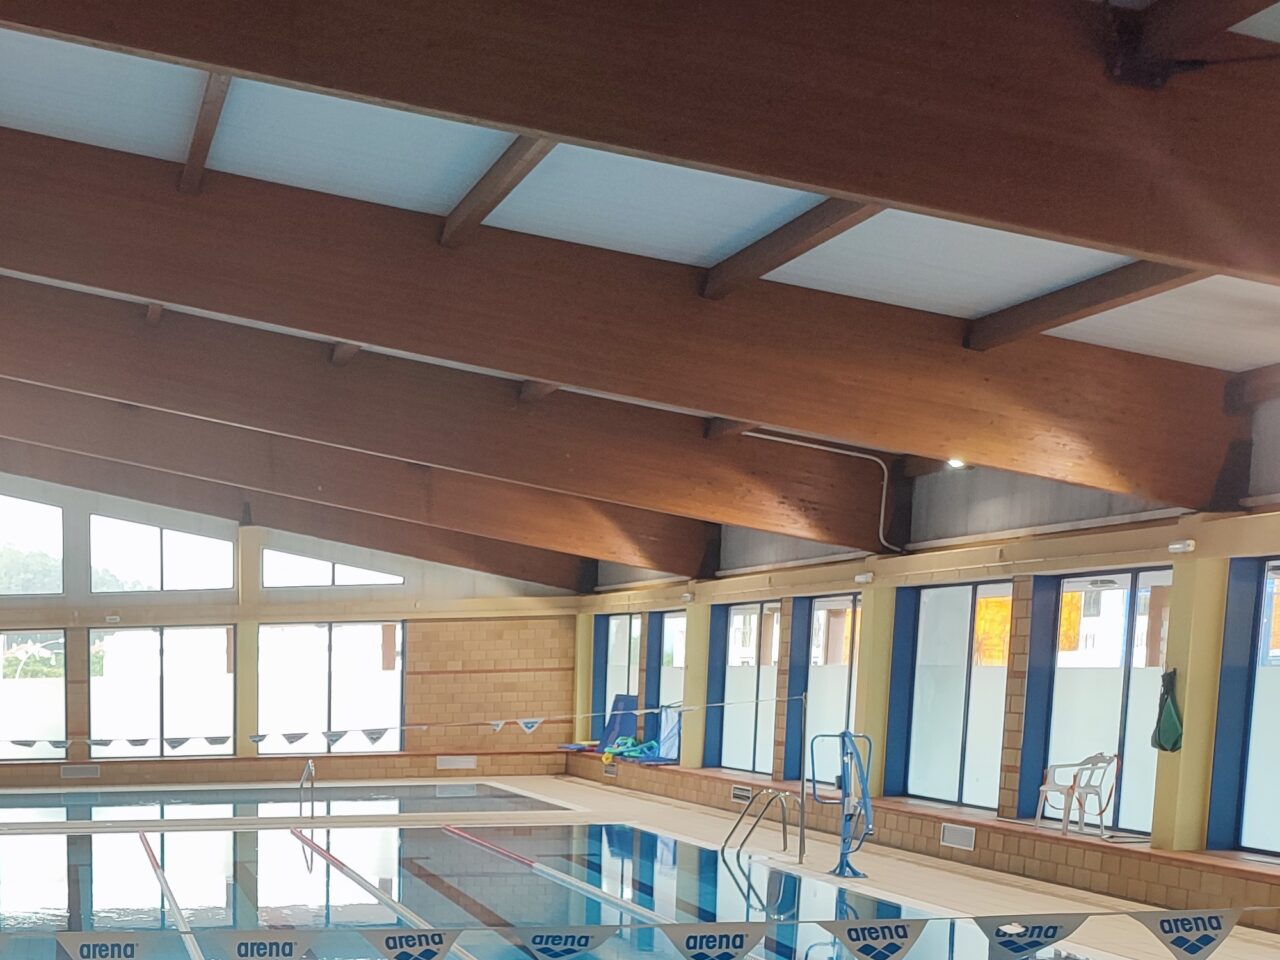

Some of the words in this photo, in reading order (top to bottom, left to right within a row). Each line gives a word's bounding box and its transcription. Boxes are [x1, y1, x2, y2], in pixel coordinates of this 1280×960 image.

[847, 924, 908, 942] arena
[1159, 915, 1222, 934] arena
[385, 932, 443, 949] arena
[532, 934, 589, 947] arena
[686, 934, 744, 950] arena
[79, 942, 134, 959] arena
[237, 941, 293, 958] arena
